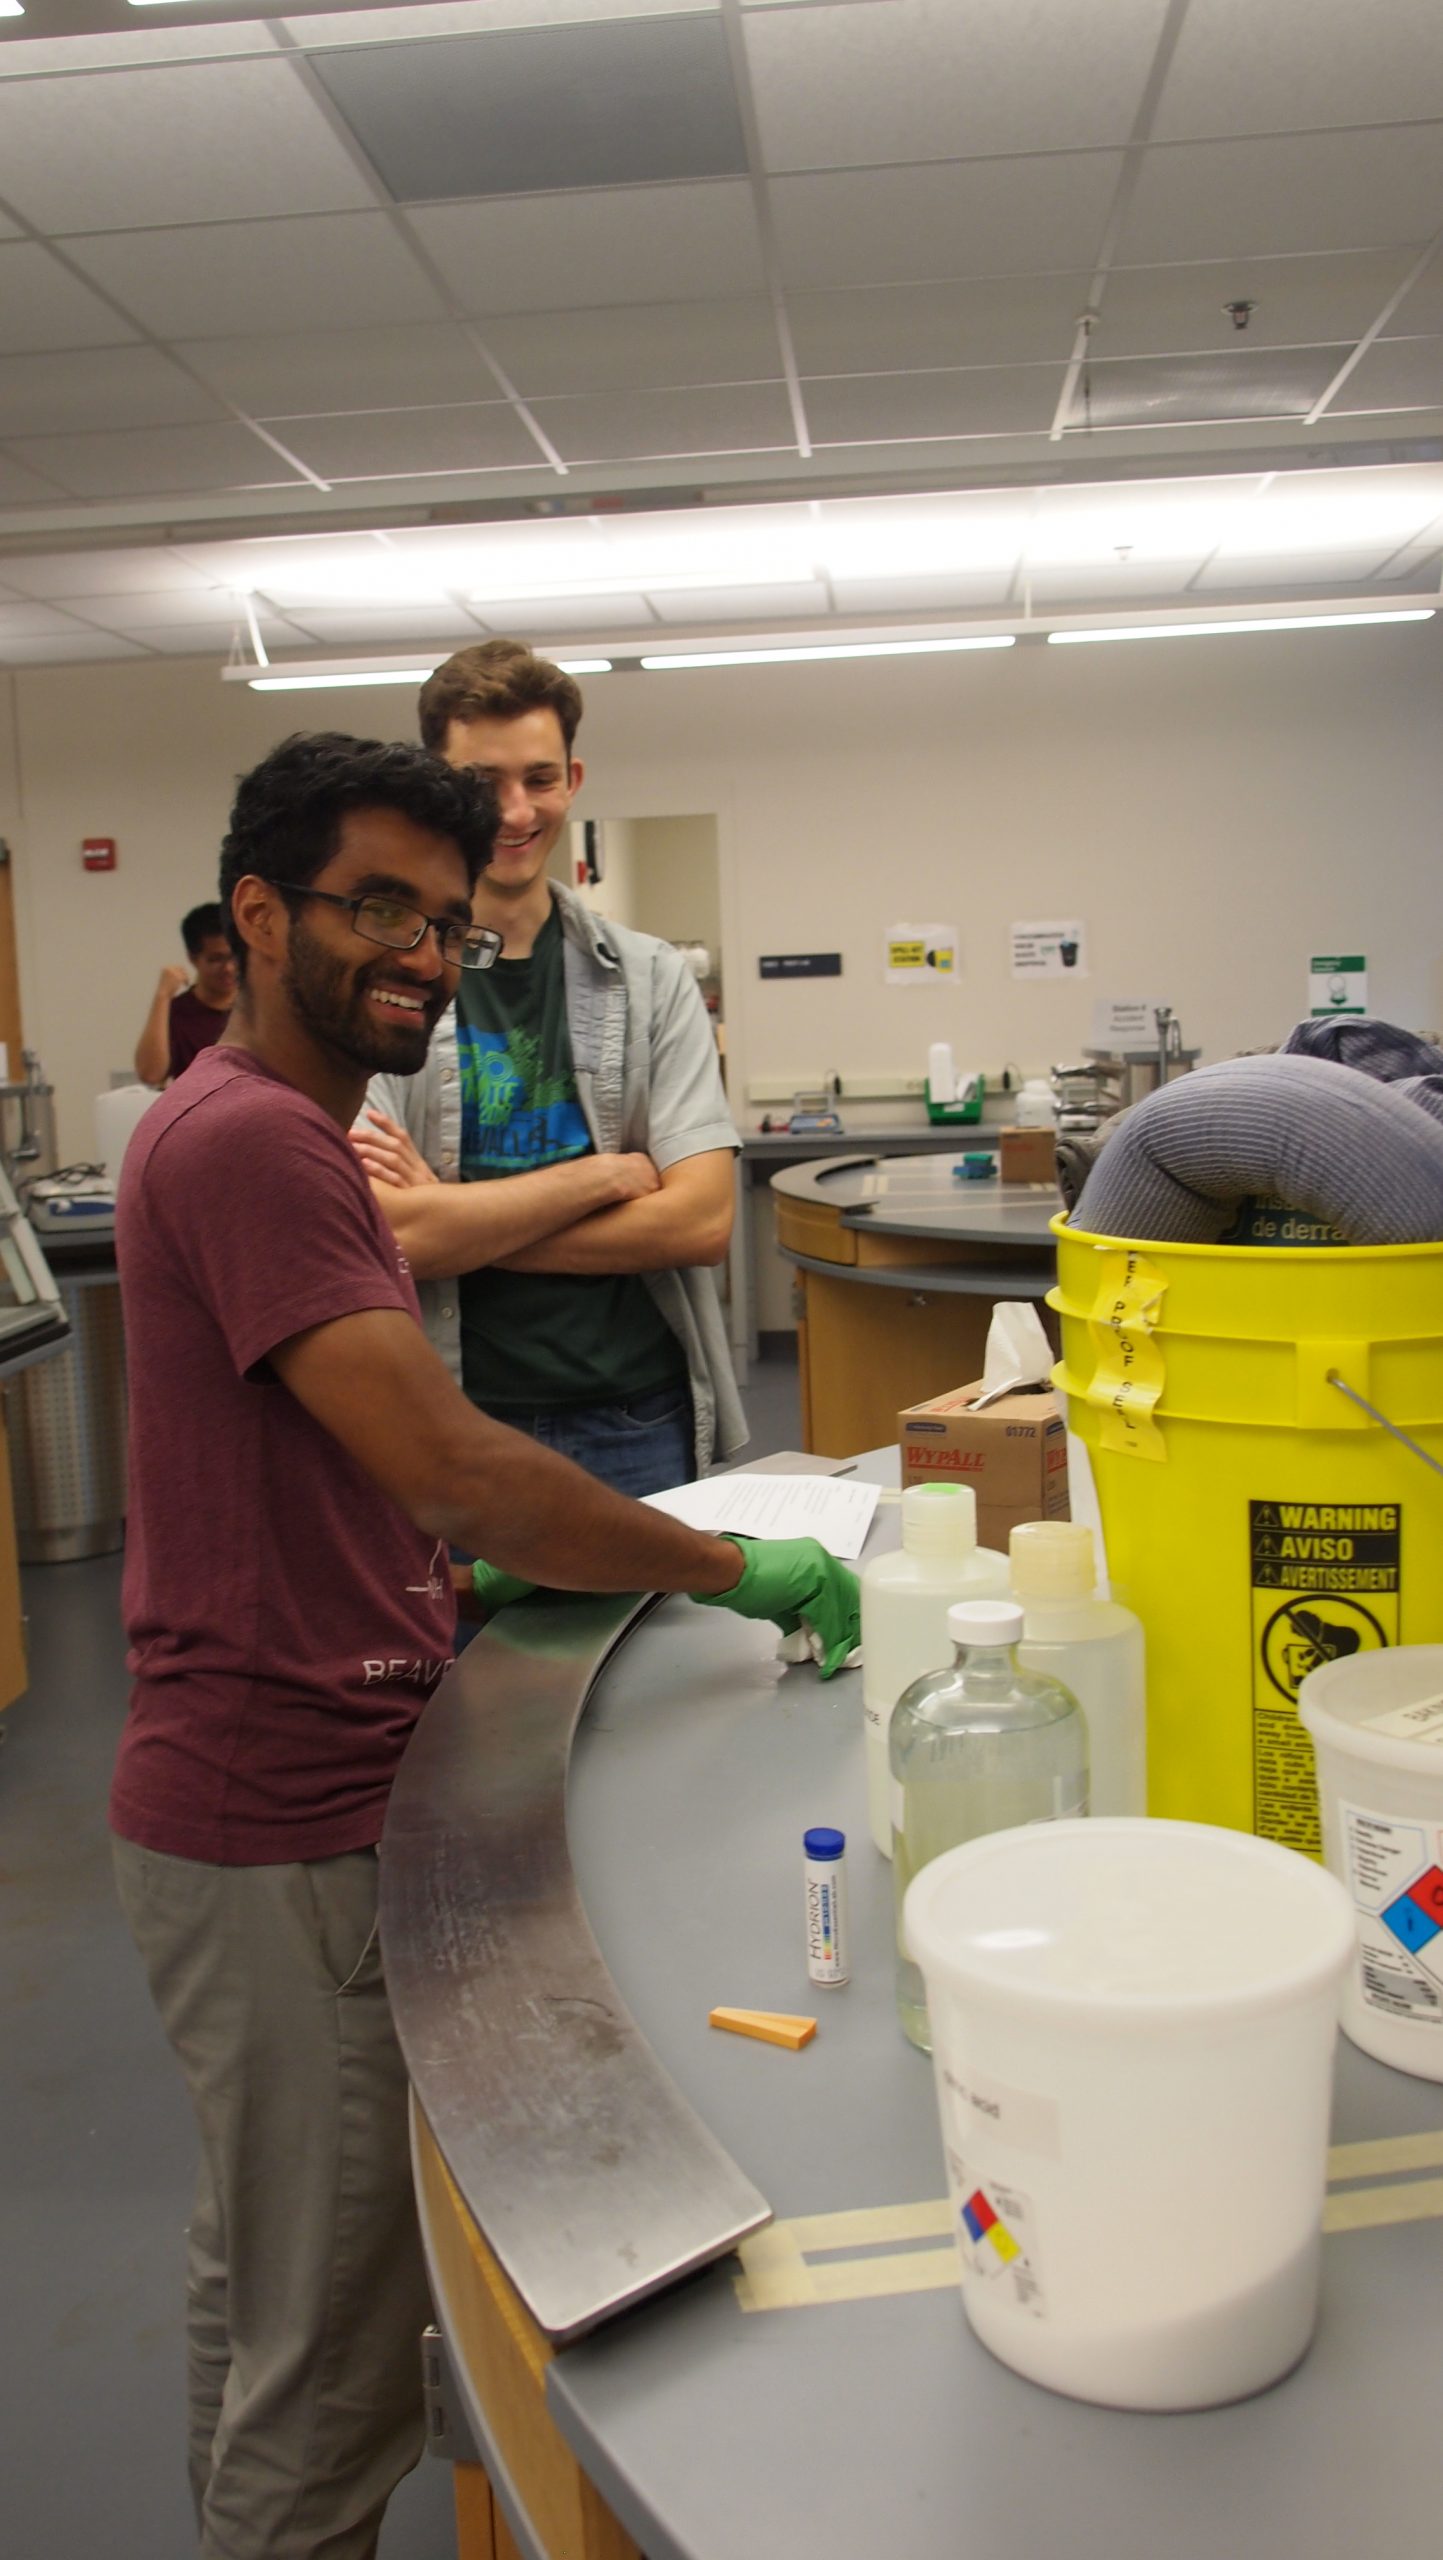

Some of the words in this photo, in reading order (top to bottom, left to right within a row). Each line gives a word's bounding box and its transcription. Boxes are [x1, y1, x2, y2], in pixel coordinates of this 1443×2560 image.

[1251, 1217, 1277, 1238] de
[1279, 1505, 1397, 1532] WARNING
[1280, 1536, 1355, 1561] AVISO
[1280, 1565, 1397, 1590] AVERTISSEMENT
[808, 1881, 821, 1960] HYDRION
